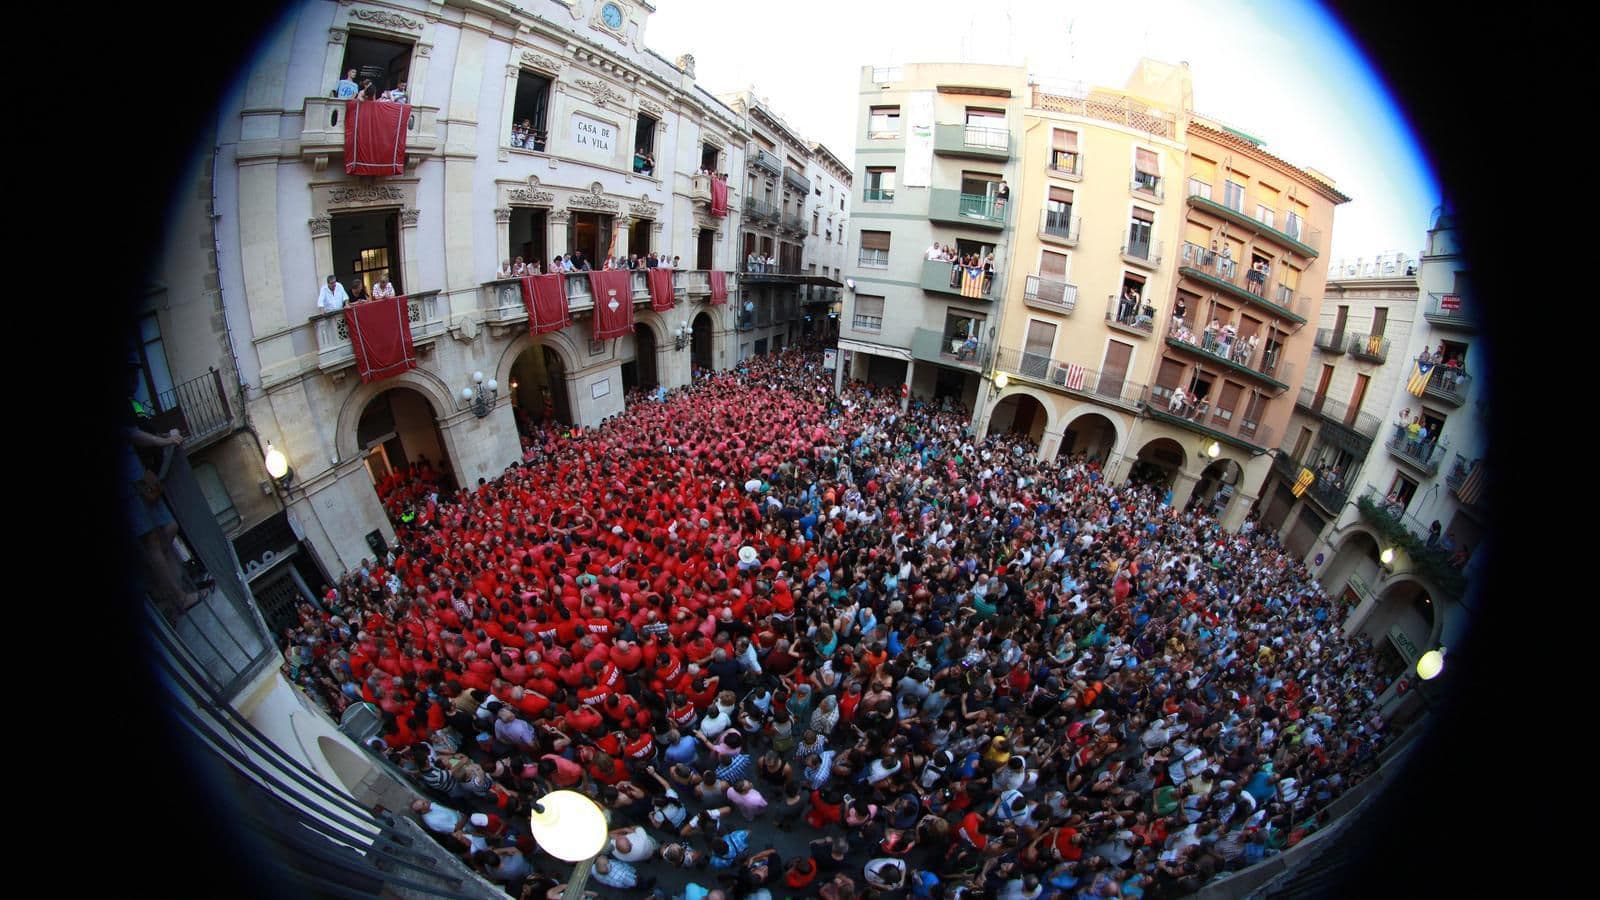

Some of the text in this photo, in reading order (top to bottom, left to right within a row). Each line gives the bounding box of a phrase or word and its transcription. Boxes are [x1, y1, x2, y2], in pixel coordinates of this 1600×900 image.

[578, 121, 610, 138] CASA DE
[577, 133, 609, 150] LA VILA
